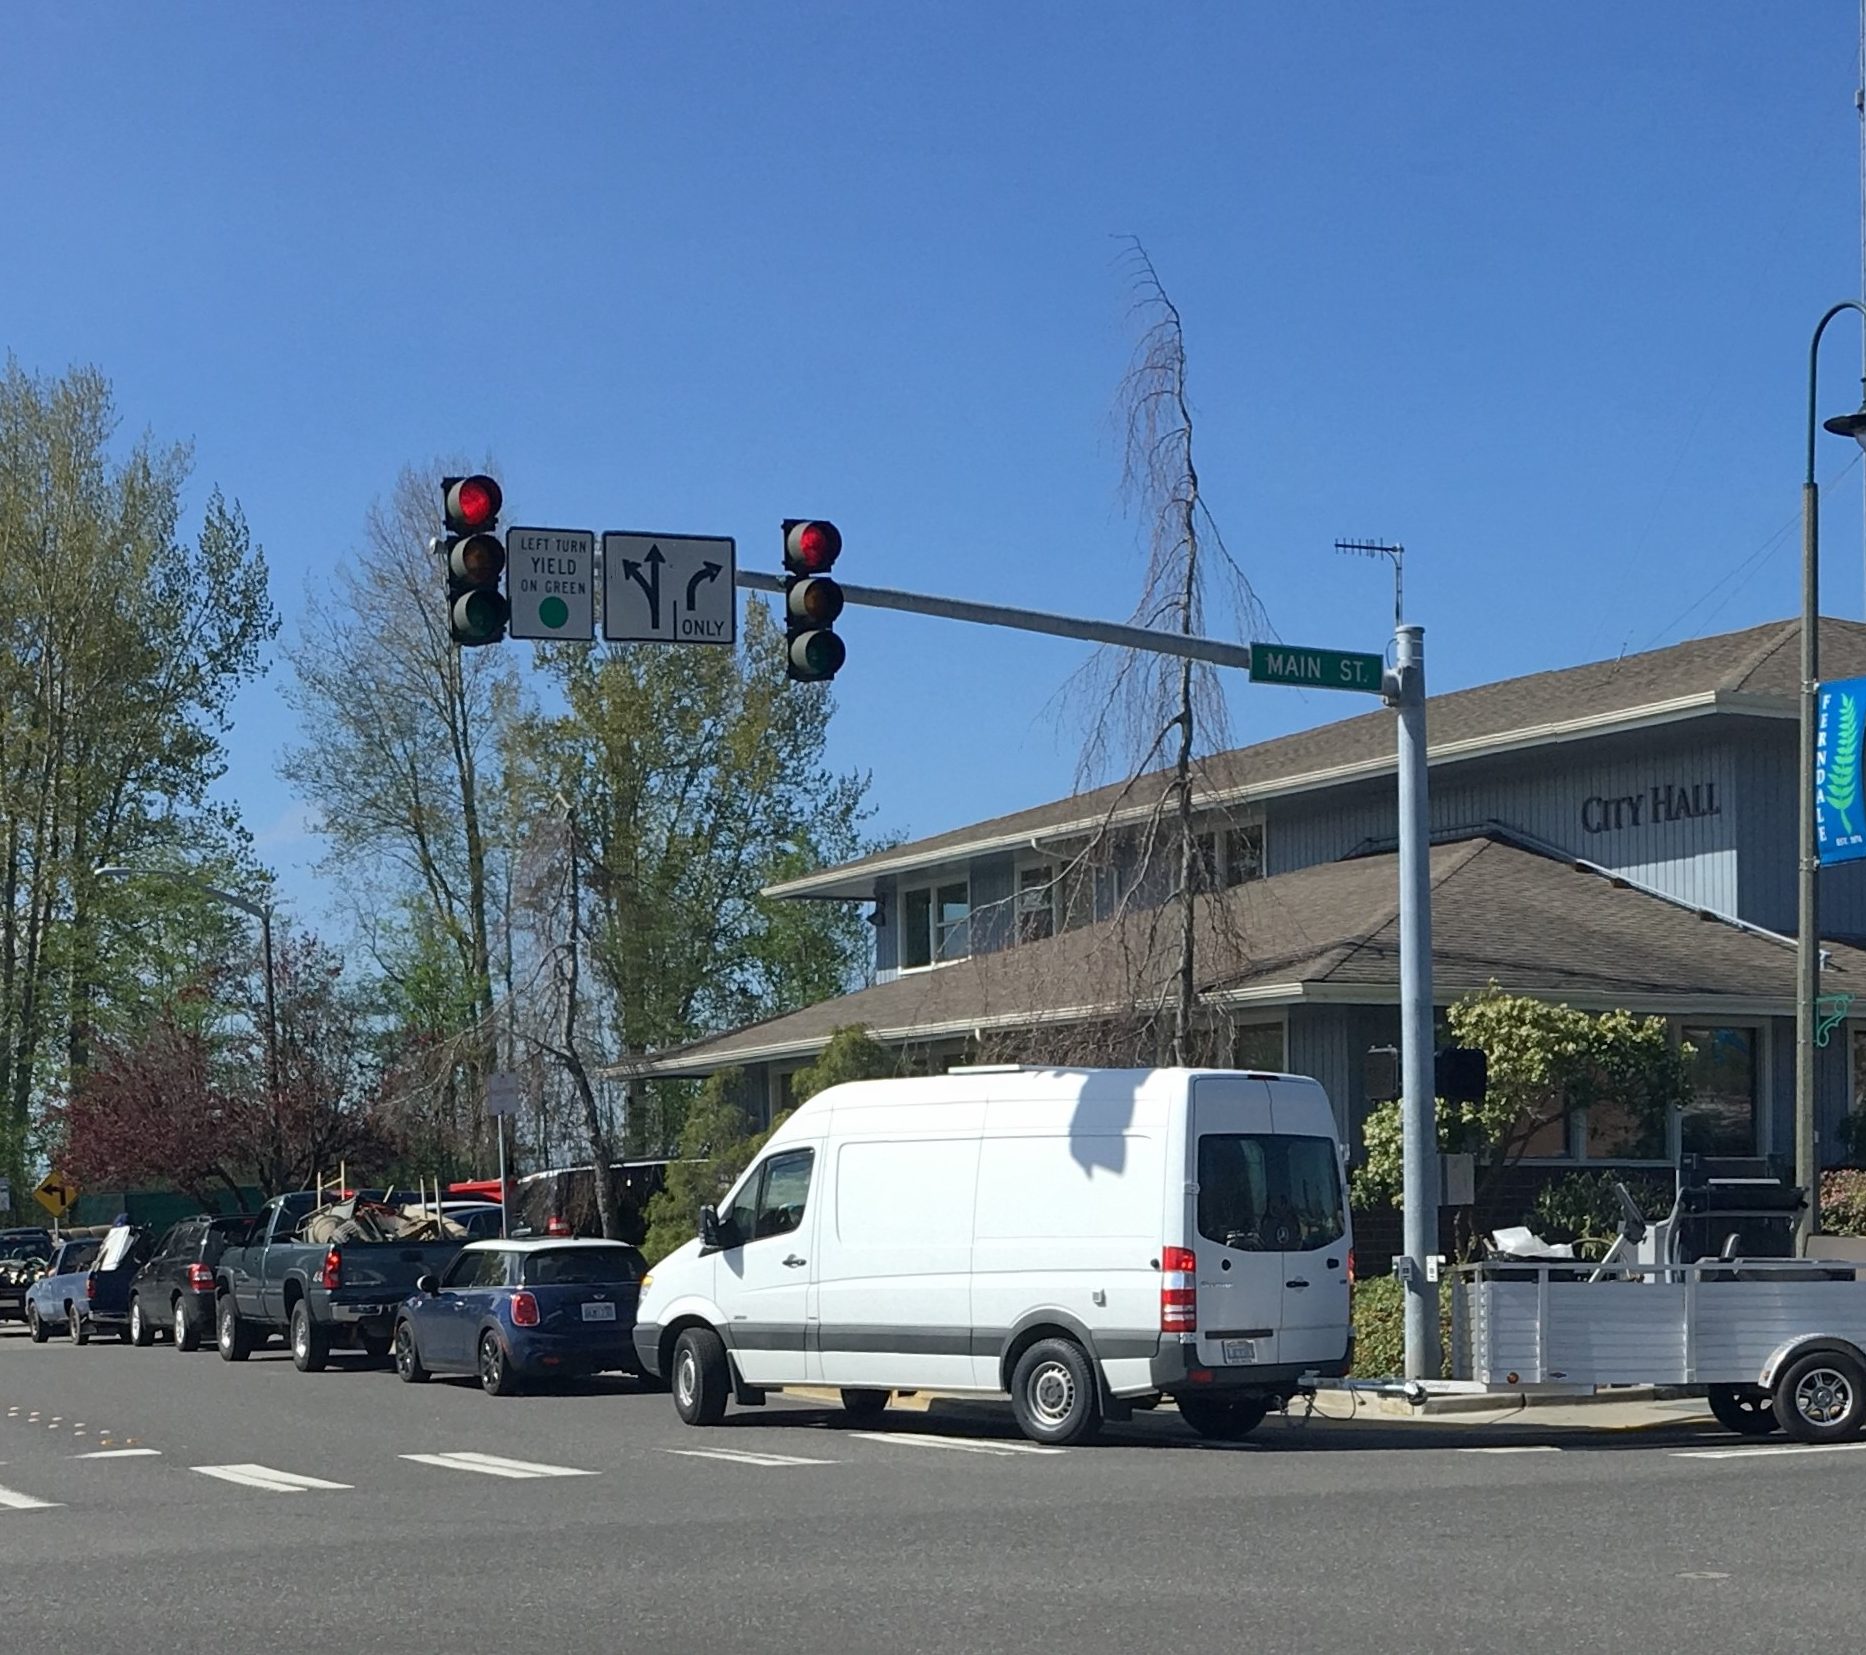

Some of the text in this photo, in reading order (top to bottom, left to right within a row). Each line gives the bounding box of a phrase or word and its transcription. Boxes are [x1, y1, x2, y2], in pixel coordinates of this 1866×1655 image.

[520, 537, 587, 554] LEFT TURN
[530, 556, 577, 576] YIELD
[520, 579, 586, 595] ON GREEN
[682, 618, 725, 637] ONLY
[1266, 652, 1369, 683] MAIN ST.
[1815, 693, 1832, 843] FERNDALE
